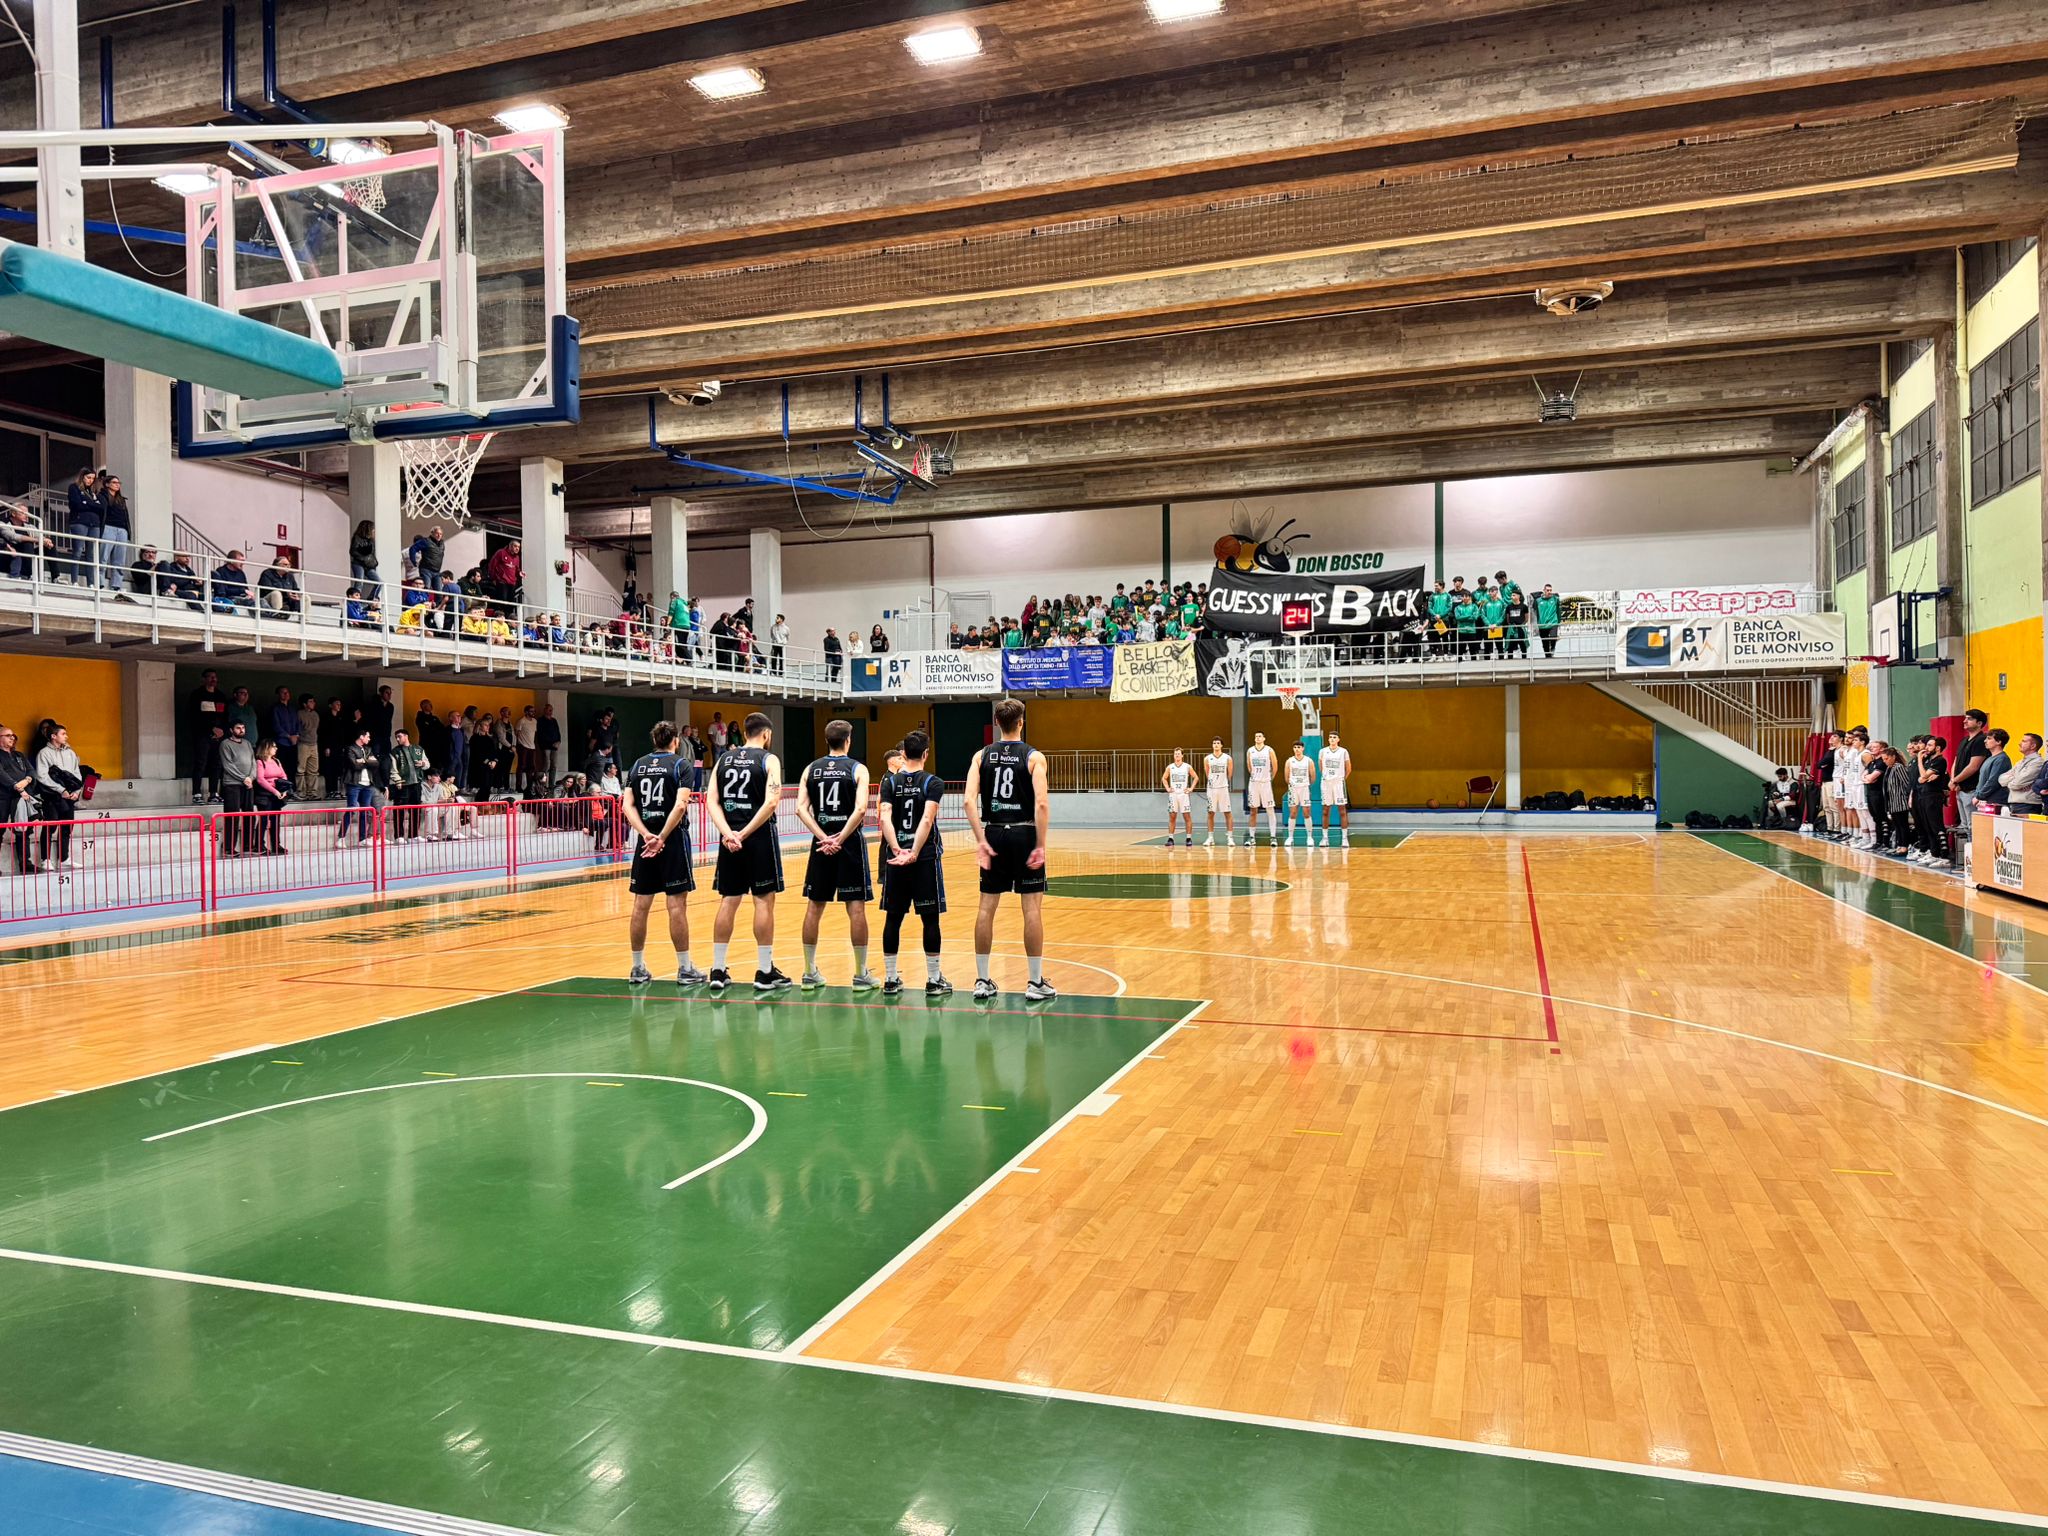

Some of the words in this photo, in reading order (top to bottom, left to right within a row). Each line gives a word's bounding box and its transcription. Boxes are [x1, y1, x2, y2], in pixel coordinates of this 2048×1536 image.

[1296, 556, 1328, 573] DON
[1329, 552, 1384, 571] BOSCO
[1209, 587, 1272, 615] GUESS
[1272, 592, 1327, 616] W'S
[1672, 590, 1796, 614] Kappa
[1285, 607, 1309, 625] 24
[1682, 626, 1712, 643] BT
[1733, 620, 1783, 632] BANCA
[1733, 631, 1801, 643] TERRITORI
[1123, 645, 1172, 662] BELLO
[1734, 644, 1758, 655] DEL
[1762, 641, 1834, 655] MONVISO
[889, 659, 910, 672] BT
[925, 654, 960, 664] BANCA
[925, 664, 972, 673] TERRITORI
[925, 674, 942, 683] DEL
[944, 672, 994, 683] MONVISO
[127, 782, 134, 790] 8
[723, 768, 751, 799] 22
[992, 766, 1014, 799] 18
[640, 777, 665, 807] 94
[818, 781, 841, 811] 14
[902, 798, 914, 829] 3
[82, 840, 94, 850] 37
[1996, 859, 2022, 881] CROCETTA
[58, 875, 70, 885] 51
